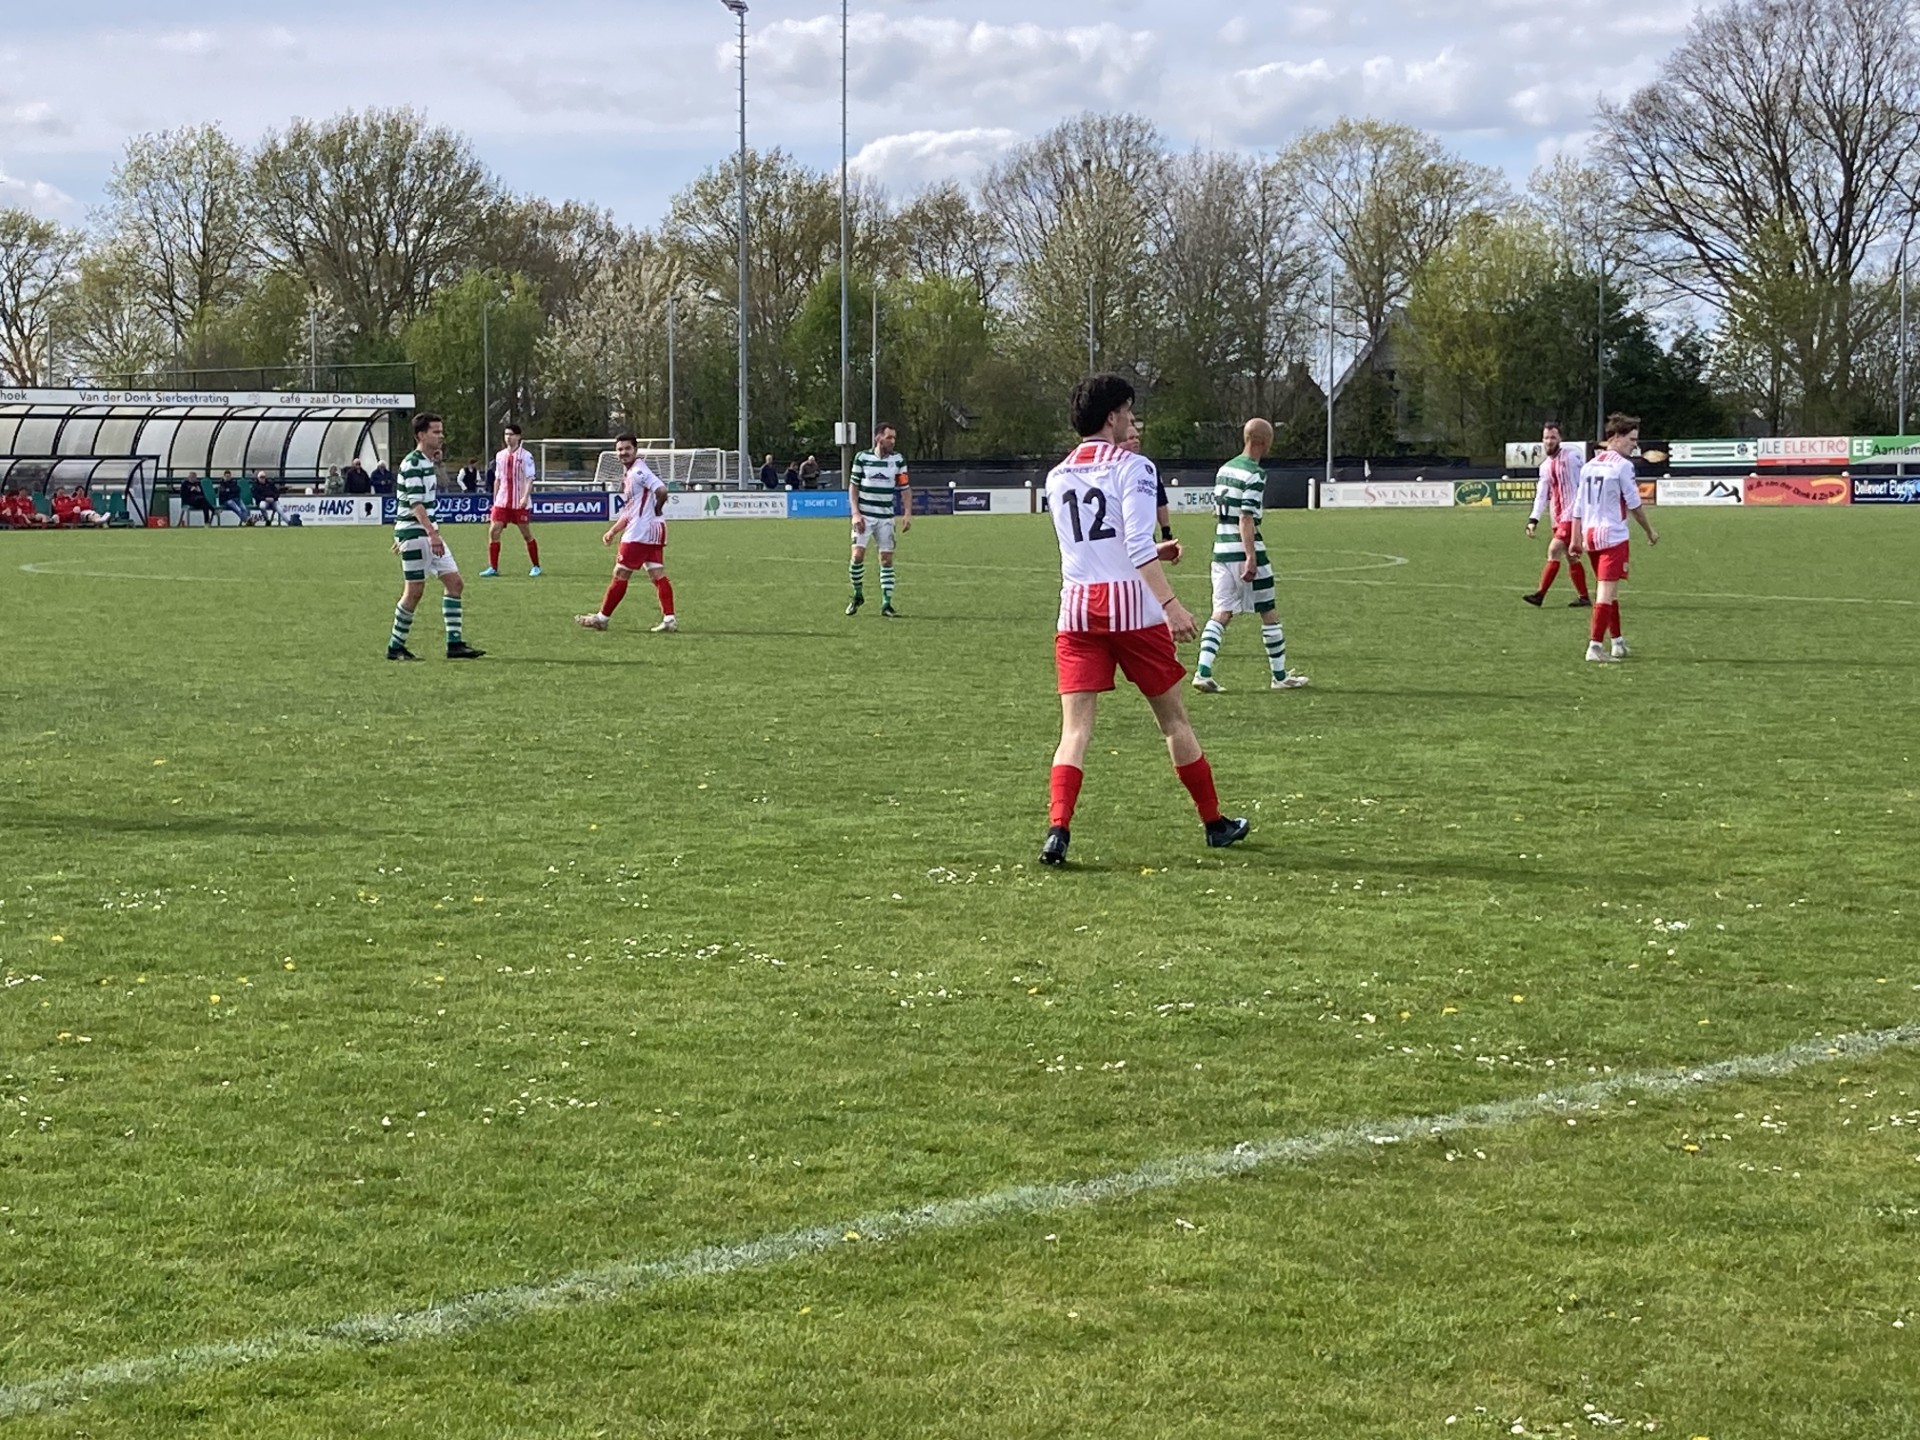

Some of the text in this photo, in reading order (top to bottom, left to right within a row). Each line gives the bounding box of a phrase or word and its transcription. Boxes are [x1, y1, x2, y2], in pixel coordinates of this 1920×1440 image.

[79, 391, 230, 405] Van der Donk Sierbestrating
[280, 392, 300, 404] café
[310, 393, 329, 404] zaal
[332, 394, 351, 405] Den
[355, 394, 400, 405] Driehoek
[1784, 438, 1847, 454] ELEKTRO
[1364, 485, 1450, 505] SWINKELS
[1586, 475, 1605, 505] 17
[282, 500, 354, 515] armode HANS
[533, 500, 601, 514] LOEGAM
[1062, 487, 1117, 543] 12
